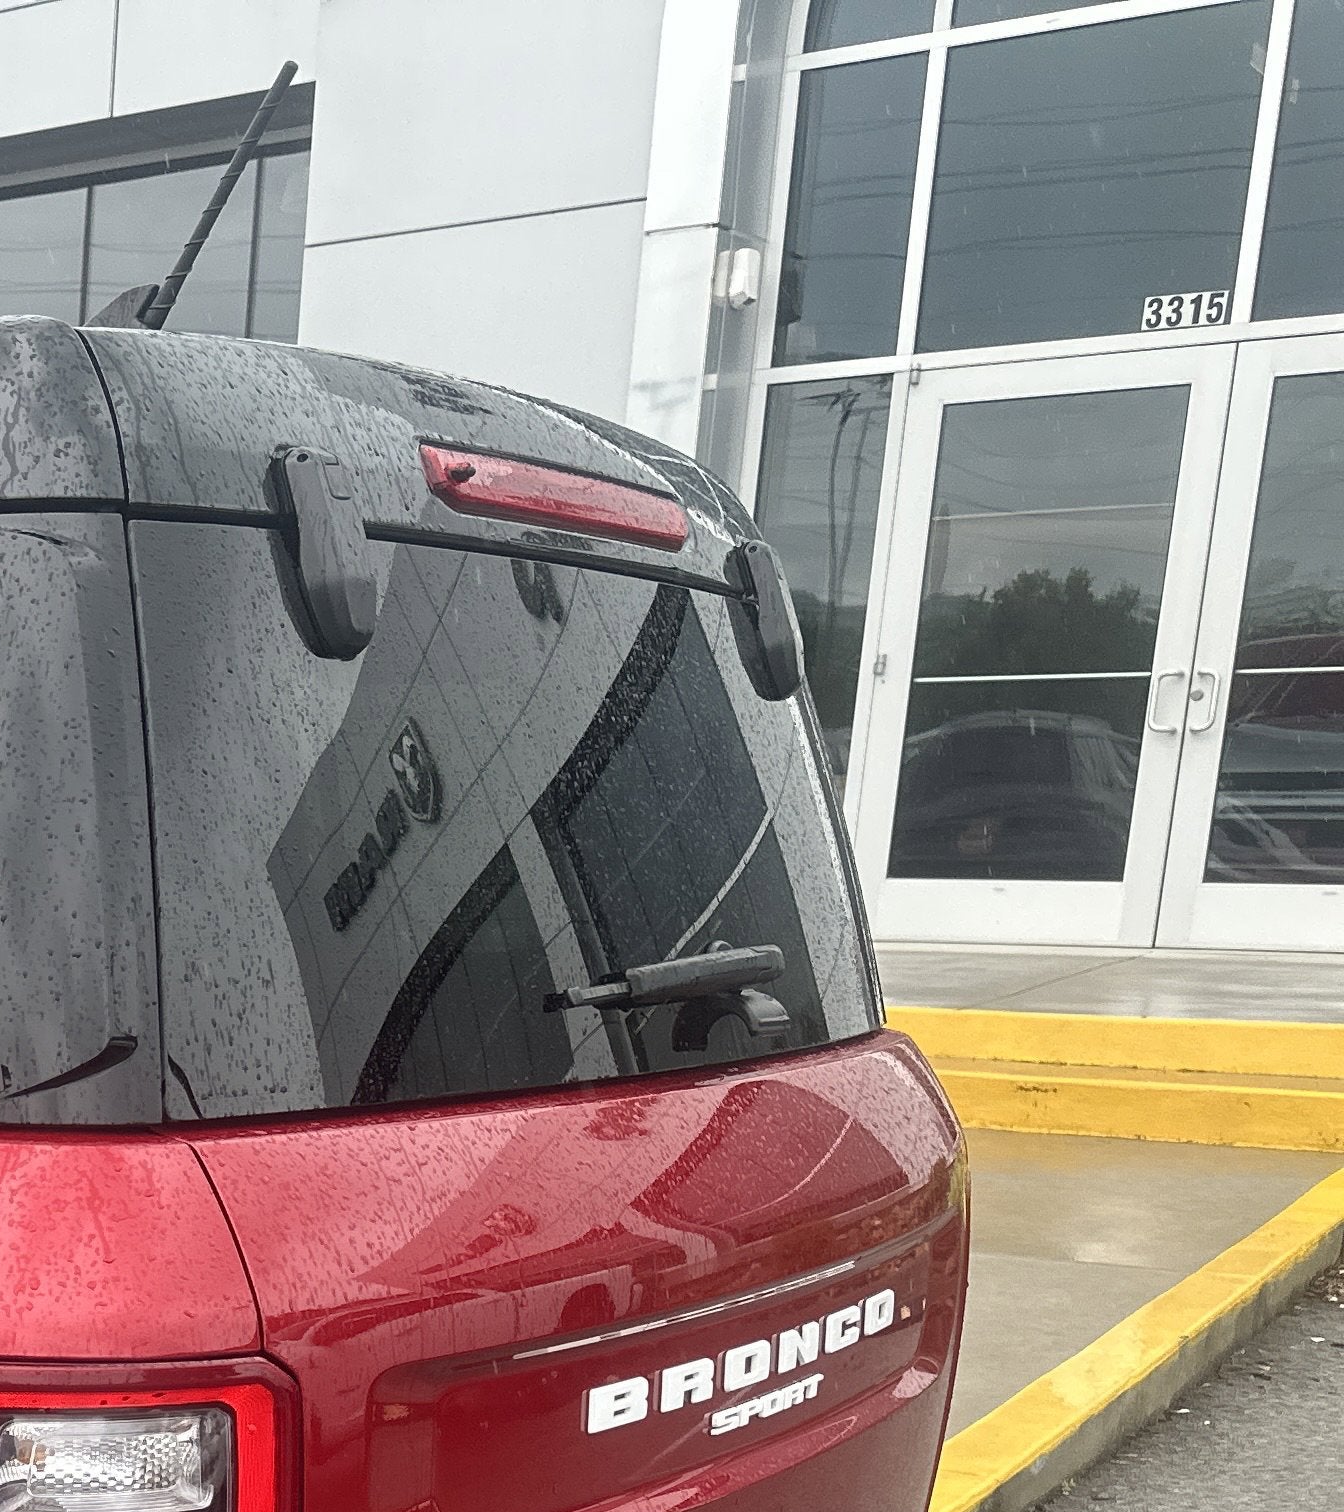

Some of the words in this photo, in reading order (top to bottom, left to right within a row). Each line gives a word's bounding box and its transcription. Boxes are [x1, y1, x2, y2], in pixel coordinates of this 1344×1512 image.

[1145, 292, 1226, 328] 3315
[582, 1288, 895, 1434] BRONCO
[705, 1373, 825, 1436] SPORT
